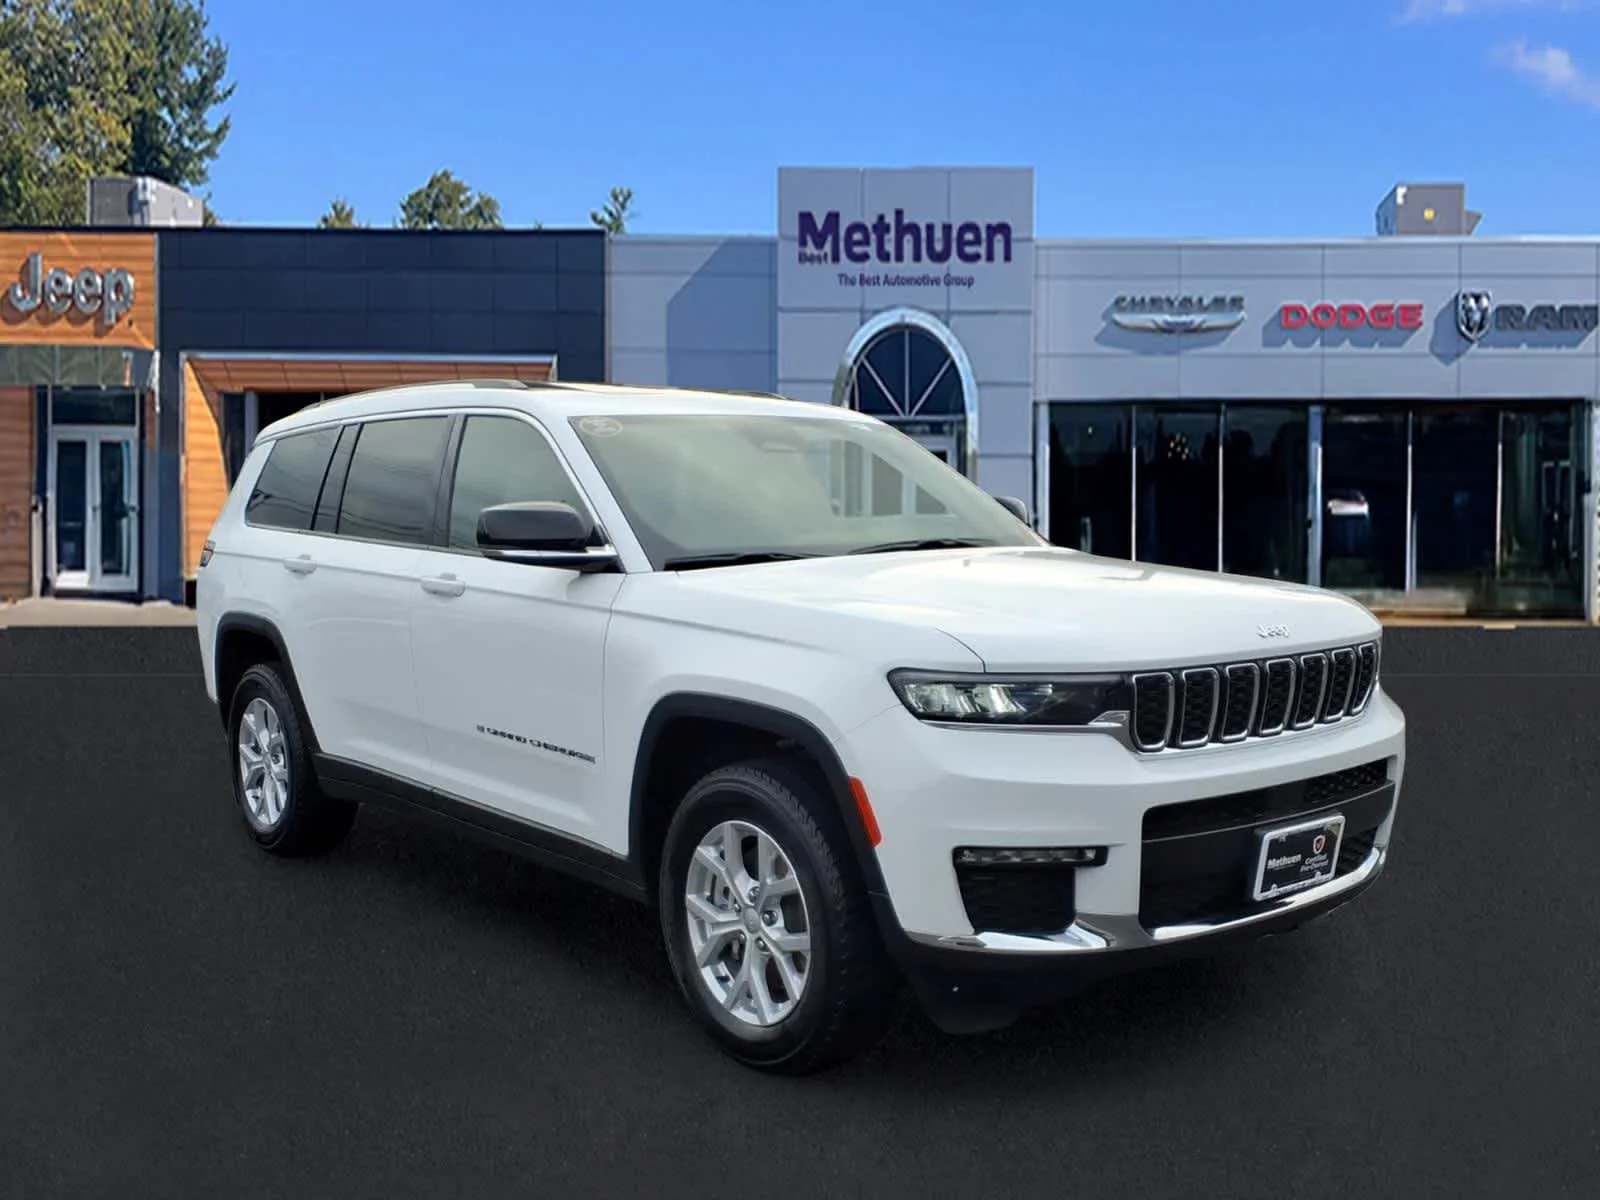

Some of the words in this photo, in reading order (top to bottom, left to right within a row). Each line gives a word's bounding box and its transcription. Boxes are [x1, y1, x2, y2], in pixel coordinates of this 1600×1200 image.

[798, 208, 1012, 263] Methuen
[9, 252, 135, 325] Jeep
[838, 274, 856, 286] The
[859, 274, 880, 287] Best
[883, 274, 941, 287] Automotive
[944, 274, 974, 288] Group
[1114, 296, 1244, 312] CHRYSLER
[1281, 303, 1423, 329] DODGE
[1494, 304, 1599, 331] RAM
[1256, 624, 1290, 639] Jeep
[1267, 854, 1302, 869] Methuen
